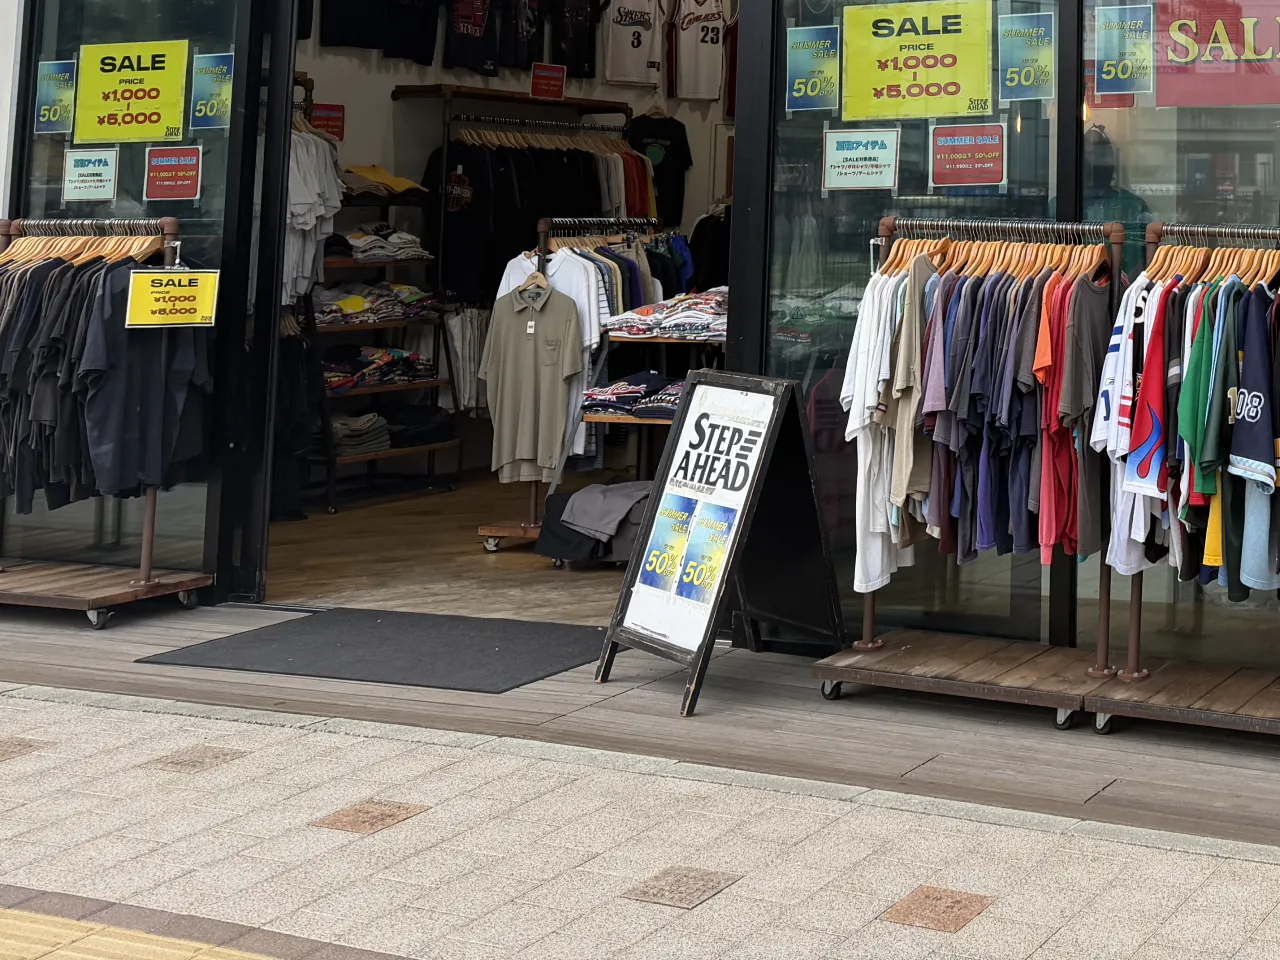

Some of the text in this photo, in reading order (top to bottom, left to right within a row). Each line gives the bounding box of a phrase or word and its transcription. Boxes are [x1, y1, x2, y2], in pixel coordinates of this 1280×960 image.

[872, 15, 962, 38] SALE
[1100, 20, 1143, 30] SUMMER
[631, 31, 642, 48] 3
[700, 25, 720, 45] 23
[1002, 28, 1045, 38] SUMMER
[1123, 30, 1149, 39] SALE
[791, 40, 831, 51] SUMMER
[899, 43, 934, 51] PRICE
[1025, 38, 1050, 47] SALE
[812, 49, 836, 58] SALE
[100, 54, 166, 73] SALE
[876, 54, 957, 71] ¥1,000
[102, 88, 160, 102] ¥1,000
[872, 82, 961, 99] ¥5,000
[97, 112, 161, 126] ¥5,000
[937, 135, 999, 146] SUMMER SALE
[151, 156, 197, 165] SUMMER SALE
[150, 278, 199, 288] SALE
[689, 412, 743, 456] STEP
[673, 450, 750, 492] AHEAD
[660, 507, 688, 521] SUMMER
[671, 522, 688, 534] SALE
[697, 517, 728, 532] SUMMER
[709, 533, 728, 544] SALE
